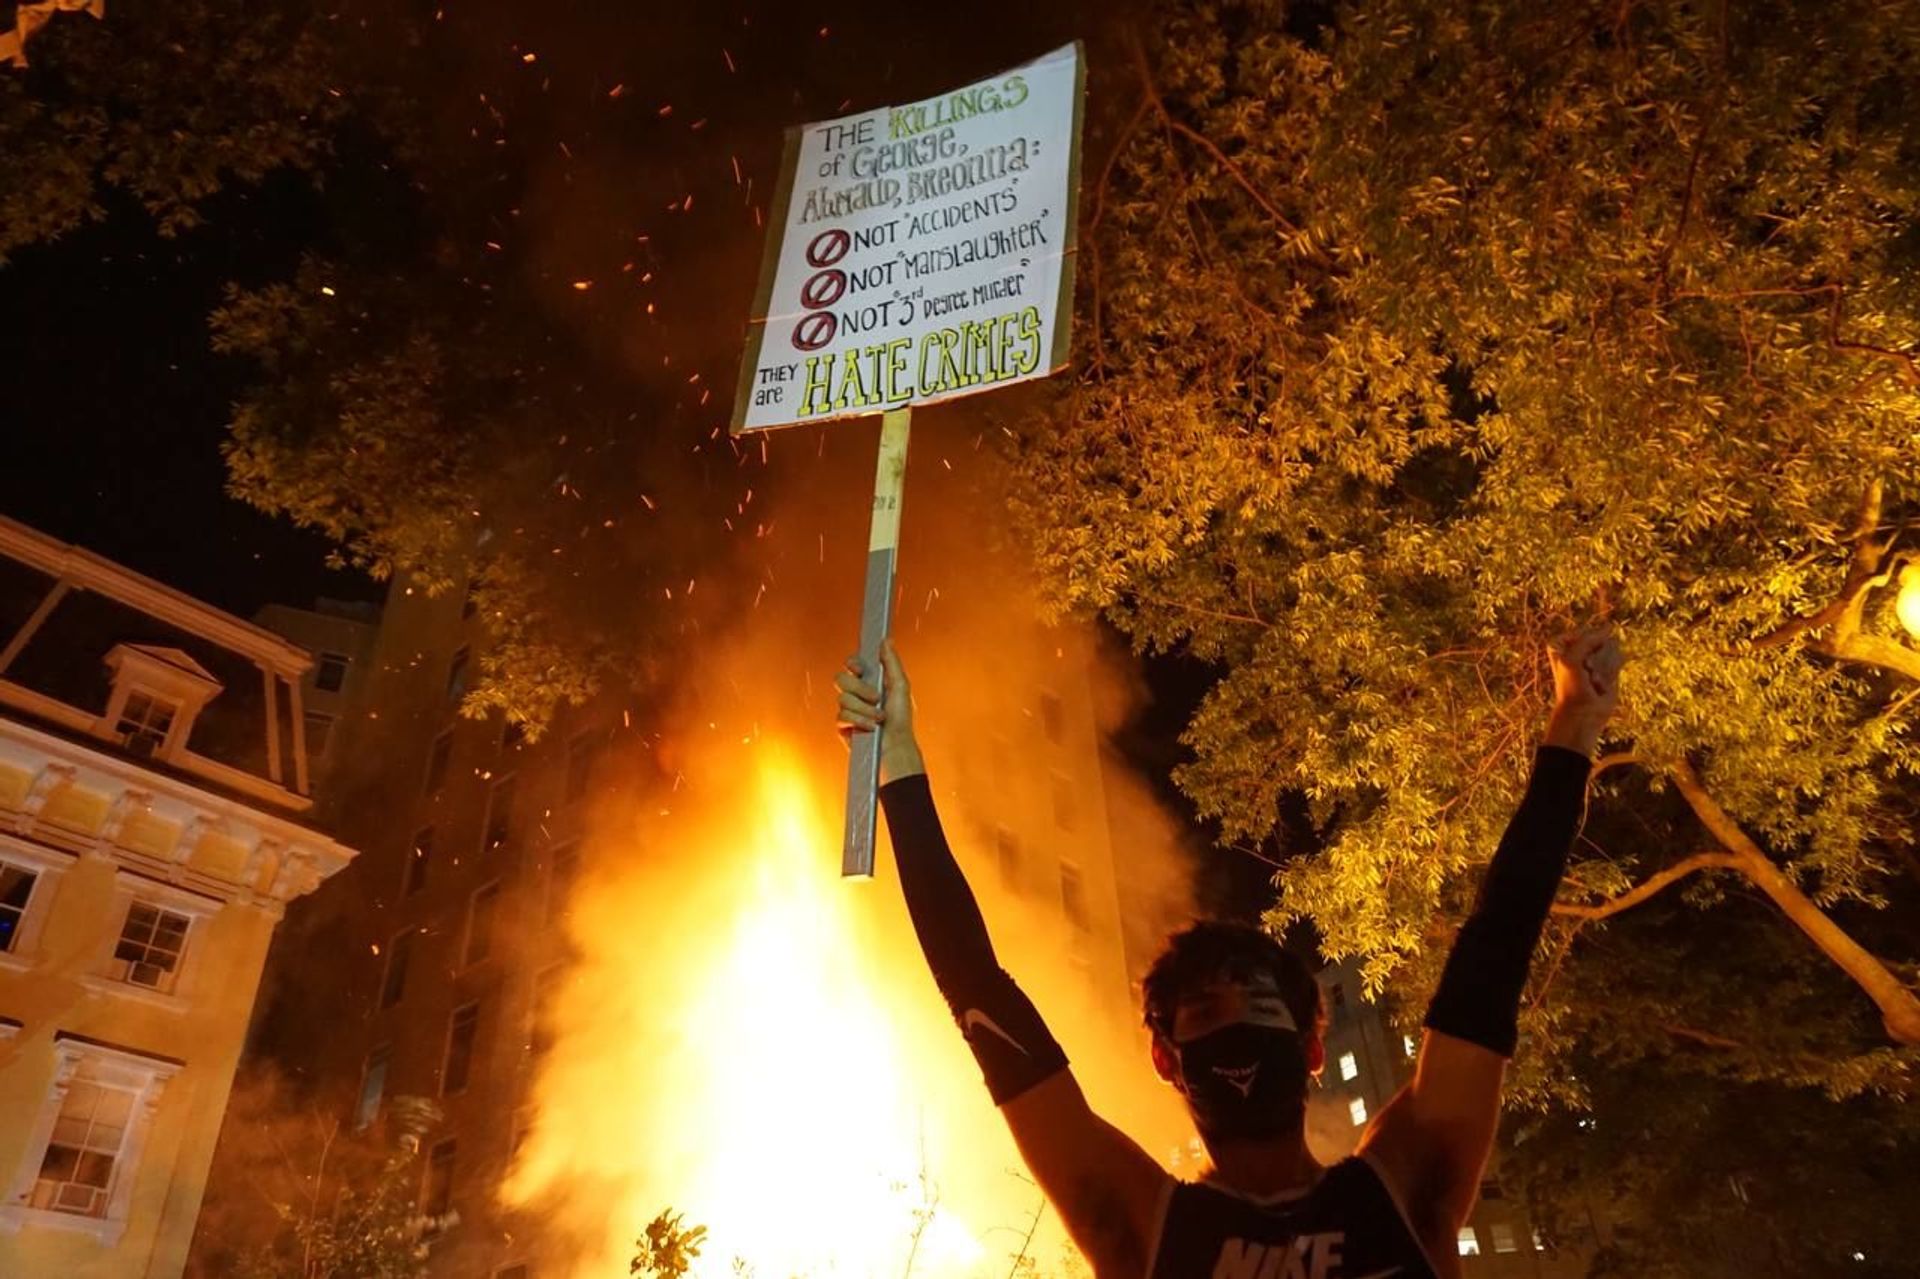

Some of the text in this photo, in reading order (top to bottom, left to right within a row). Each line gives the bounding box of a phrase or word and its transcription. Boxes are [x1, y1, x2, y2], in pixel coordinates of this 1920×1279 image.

[817, 75, 1029, 151] THE KILLINGS
[819, 153, 846, 178] of
[854, 220, 900, 252] NOT
[850, 260, 898, 294] NOT
[841, 300, 895, 336] NOT
[759, 363, 799, 385] THEY
[797, 305, 1043, 417] HATE CRIMES
[755, 386, 783, 406] are
